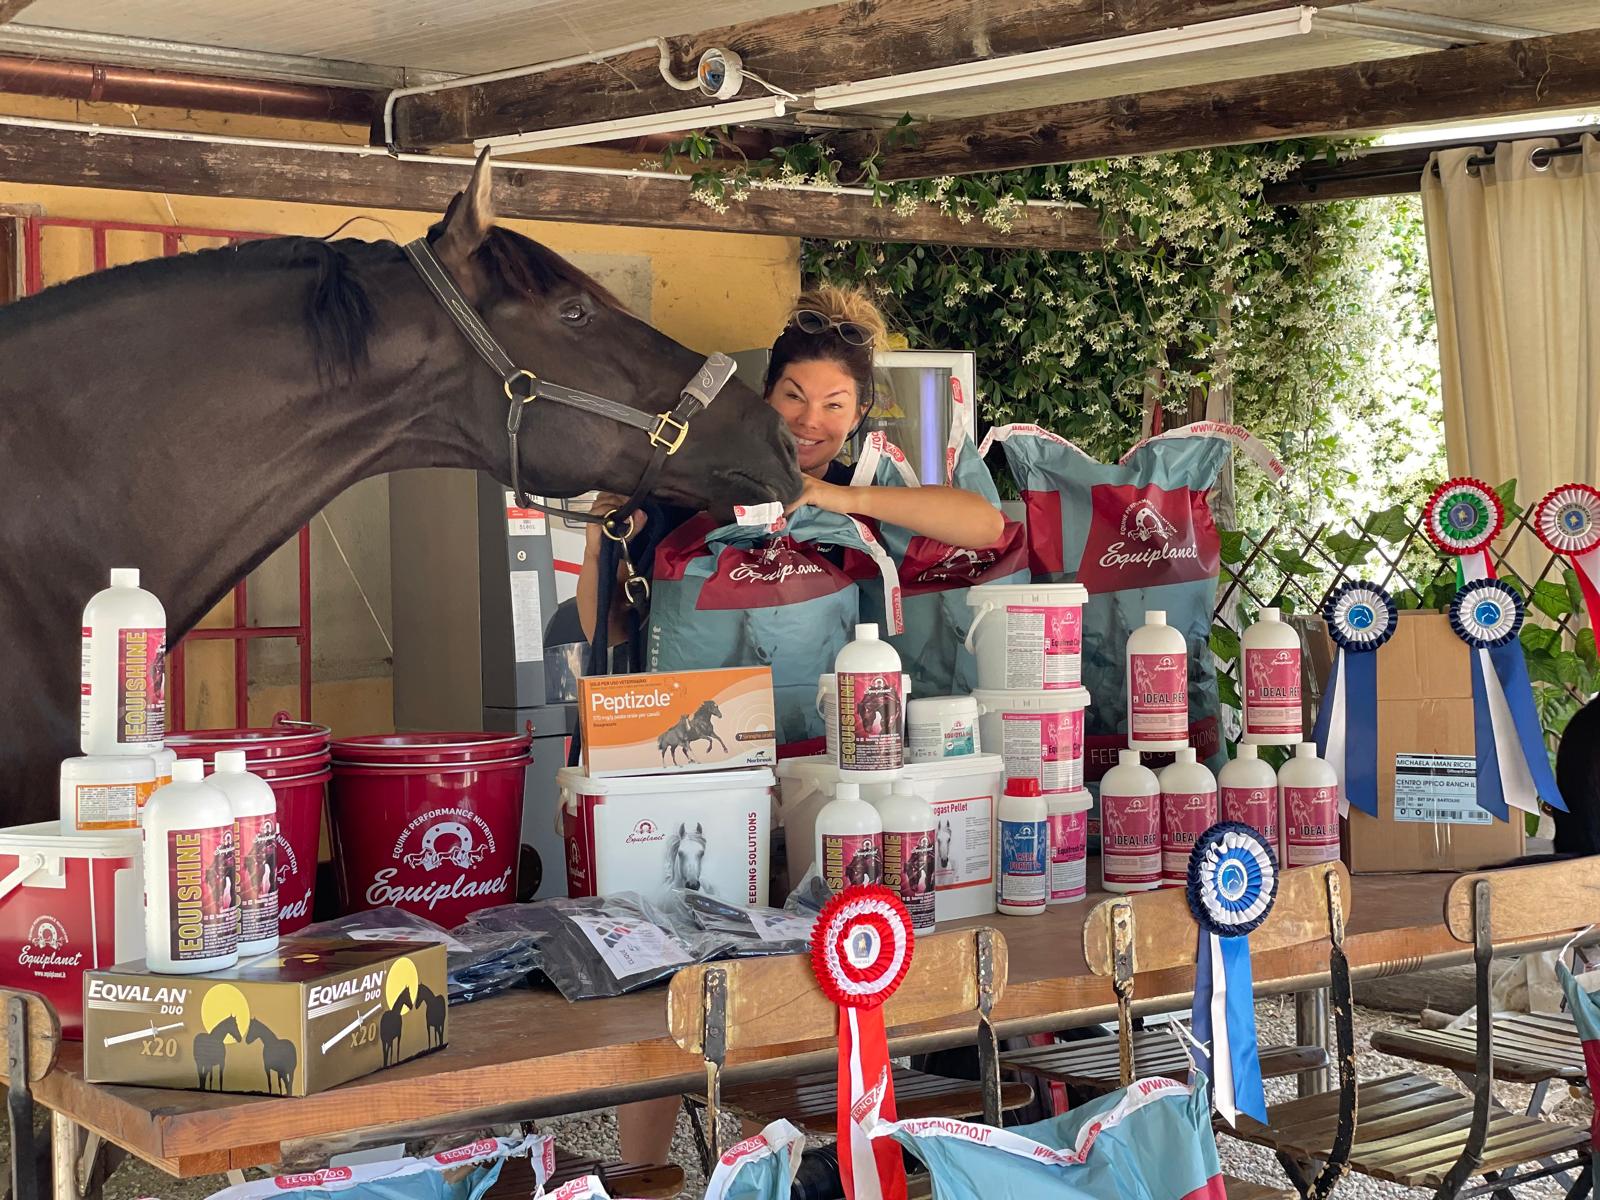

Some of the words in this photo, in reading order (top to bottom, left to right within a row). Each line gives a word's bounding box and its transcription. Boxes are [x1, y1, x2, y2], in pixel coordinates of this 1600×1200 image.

[1099, 541, 1198, 569] Equiplanet
[125, 631, 147, 736] EQUISHINE
[1260, 687, 1286, 697] IDEAL
[591, 689, 670, 714] Peptizole
[1143, 693, 1169, 703] IDEAL
[840, 674, 856, 764] EQUISHINE
[950, 802, 968, 813] Pellet
[392, 829, 412, 859] EQUINE
[408, 807, 474, 830] PERFORMANCE
[472, 815, 496, 854] NUTRITION
[748, 811, 757, 866] SOLUTIONS
[1114, 835, 1139, 846] IDEAL
[1300, 826, 1326, 836] IDEAL
[276, 834, 298, 875] NUTRITION
[176, 832, 203, 952] EQUISHINE
[365, 865, 513, 911] Equiplanet
[18, 945, 83, 969] Equiplanet
[88, 980, 186, 1004] EQVALAN
[308, 970, 384, 1009] EQVALAN
[364, 988, 382, 1002] DUO
[160, 1004, 184, 1015] DUO
[350, 1022, 377, 1048] x20
[140, 1037, 178, 1058] x20
[440, 1141, 492, 1162] TECNOZOO
[284, 1168, 346, 1185] TECNOZOO
